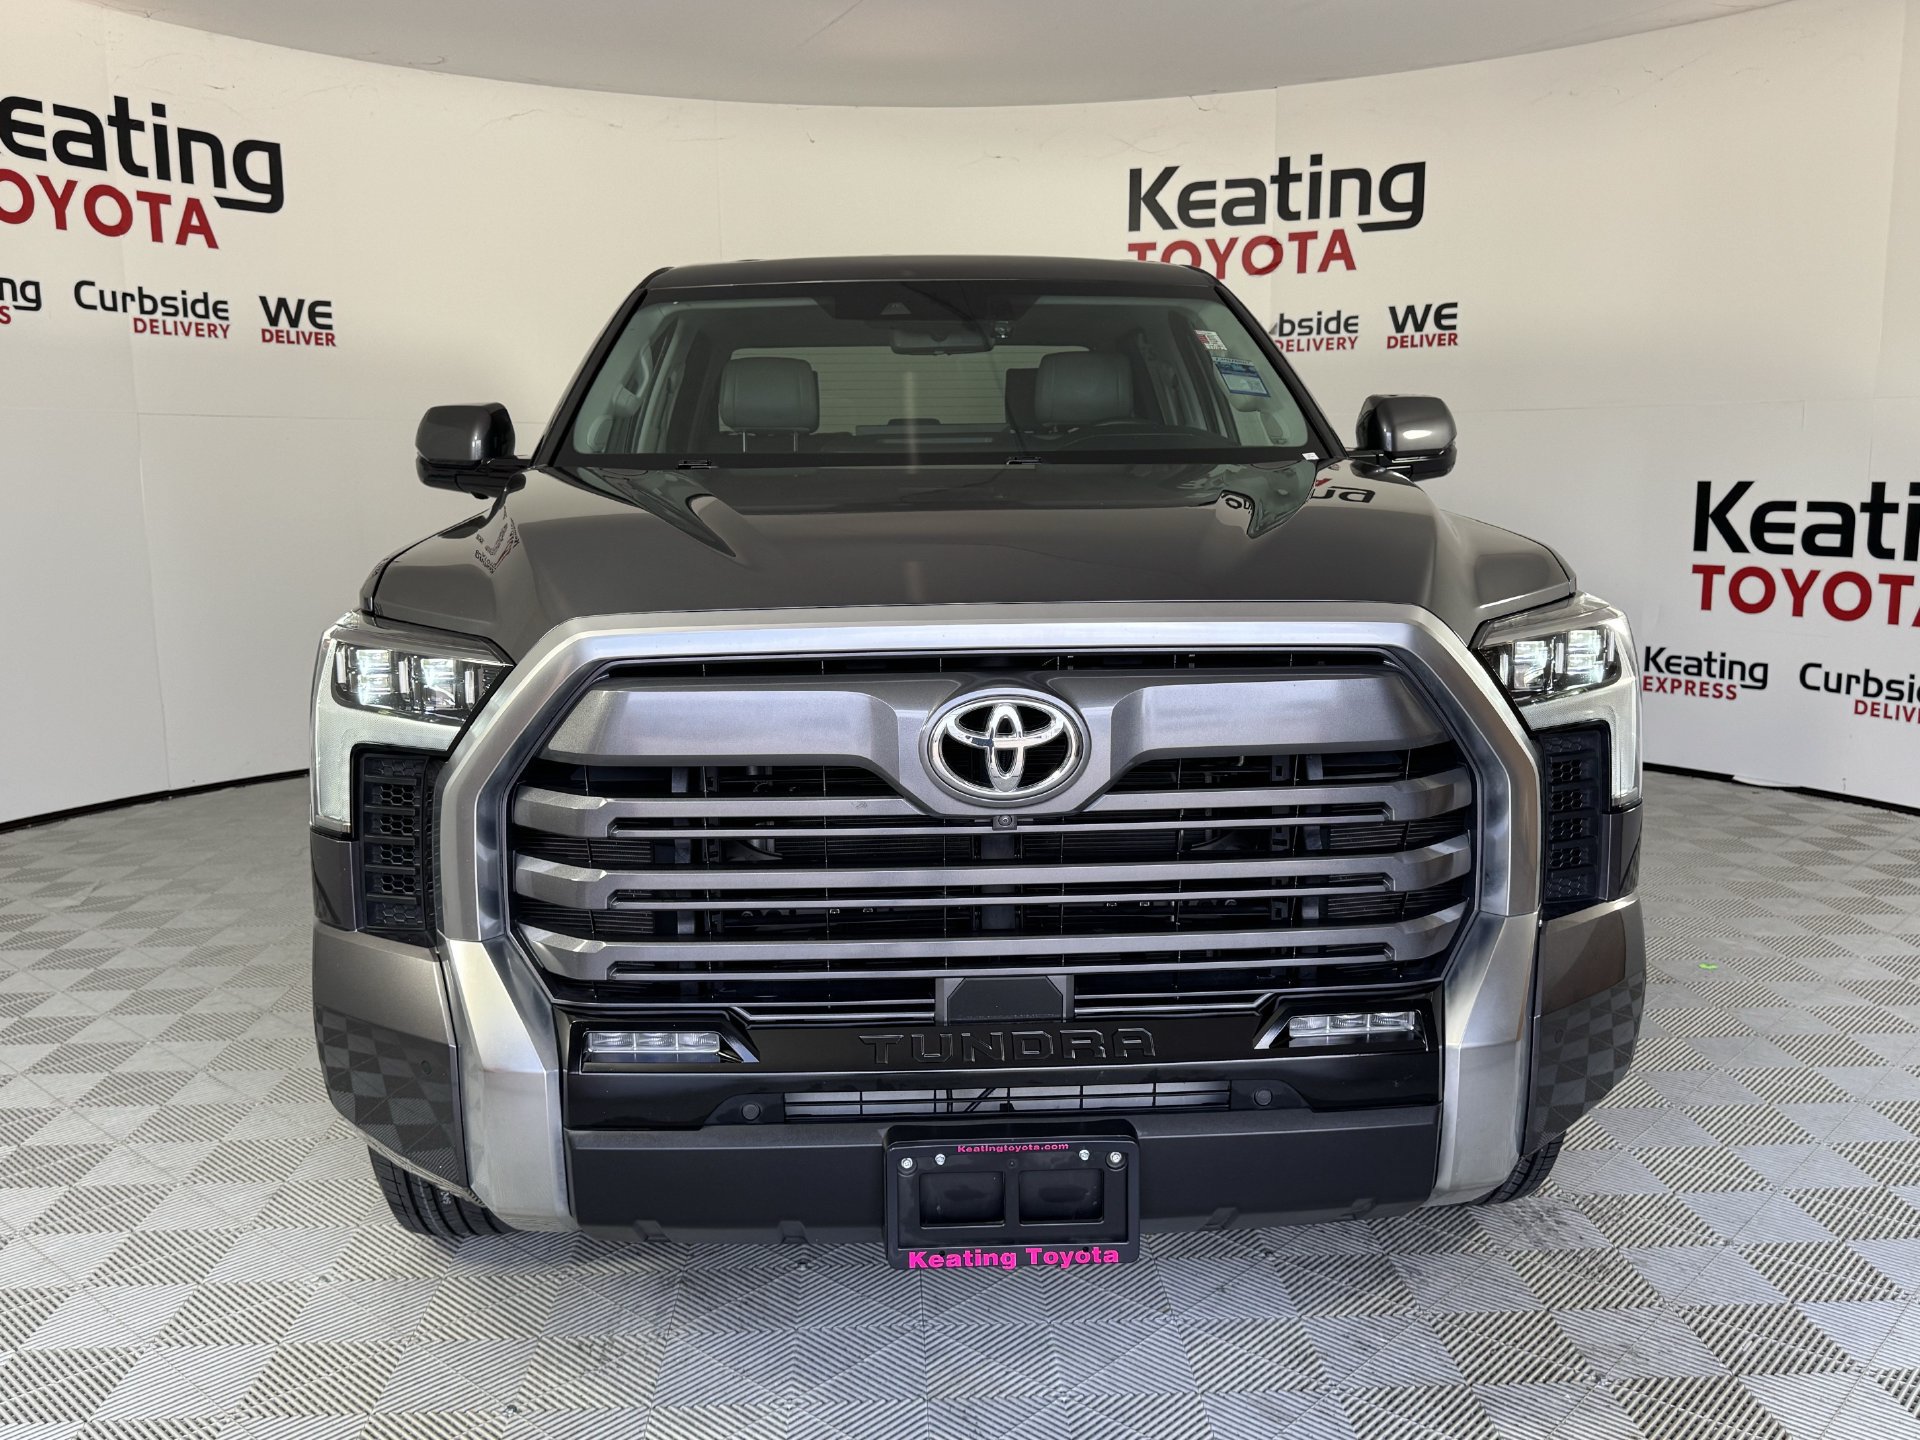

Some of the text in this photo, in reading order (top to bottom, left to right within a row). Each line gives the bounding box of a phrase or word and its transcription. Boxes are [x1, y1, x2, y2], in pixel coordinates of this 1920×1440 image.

[1127, 152, 1427, 233] Keating
[73, 279, 230, 321] Curbside
[258, 295, 334, 331] WE
[133, 317, 231, 340] DELIVERY
[1388, 301, 1459, 334] WE
[261, 328, 337, 347] DELIVER
[1386, 331, 1459, 349] DELIVER
[1691, 563, 1920, 628] TOYOT
[1643, 645, 1769, 691] Keating
[1799, 662, 1920, 704] Curbsi
[1642, 676, 1738, 701] EXPRESS
[1853, 699, 1920, 724] DELIV
[859, 1027, 1157, 1065] TUNDRA
[957, 1143, 1069, 1153] Keatingtoyota.com
[907, 1246, 1120, 1271] Keating Toyota
